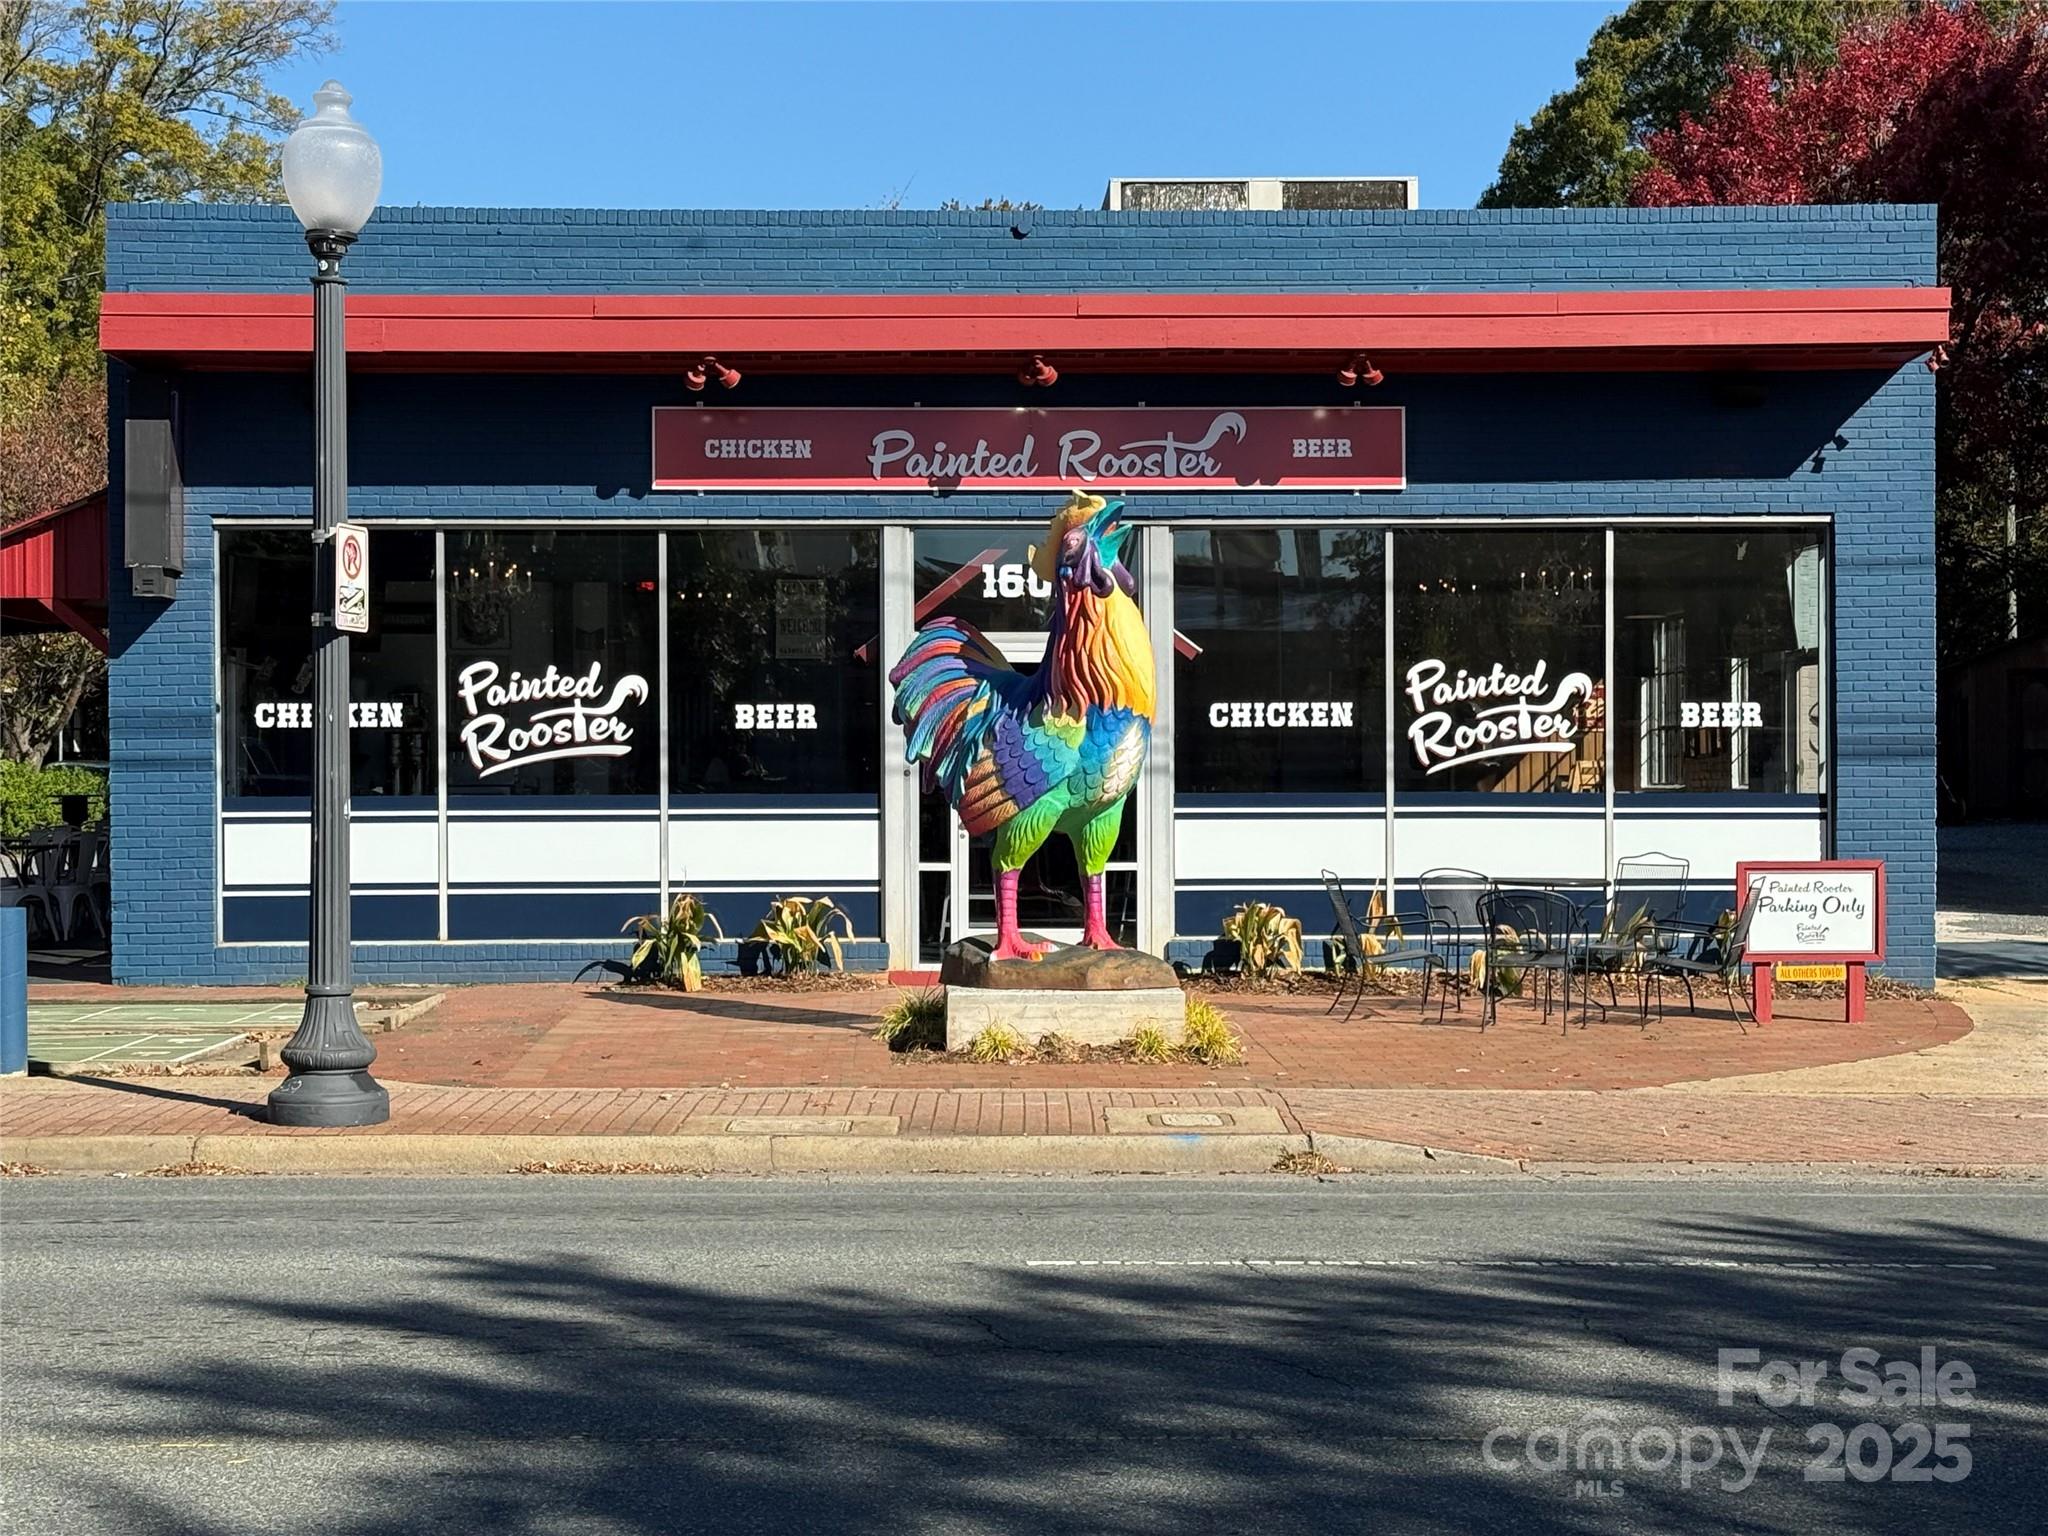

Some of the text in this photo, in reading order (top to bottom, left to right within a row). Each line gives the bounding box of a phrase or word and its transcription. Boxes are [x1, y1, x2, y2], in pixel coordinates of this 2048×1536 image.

[704, 439, 812, 459] CHICKEN
[868, 429, 1222, 481] Painted Rooster
[1292, 438, 1353, 458] BEER
[981, 563, 1055, 598] 160
[458, 660, 604, 716] Painted
[1405, 659, 1549, 713] Painted
[253, 702, 404, 729] CHIEN
[734, 703, 818, 730] BEER
[1208, 701, 1354, 728] CHICKEN
[1680, 702, 1763, 728] BEER
[460, 698, 635, 770] Rooster
[1408, 696, 1578, 767] Rooster
[1769, 880, 1854, 894] Painted Rooster
[1758, 895, 1866, 920] Parking Only
[1780, 967, 1792, 979] ALL
[1793, 967, 1818, 979] OTHERS
